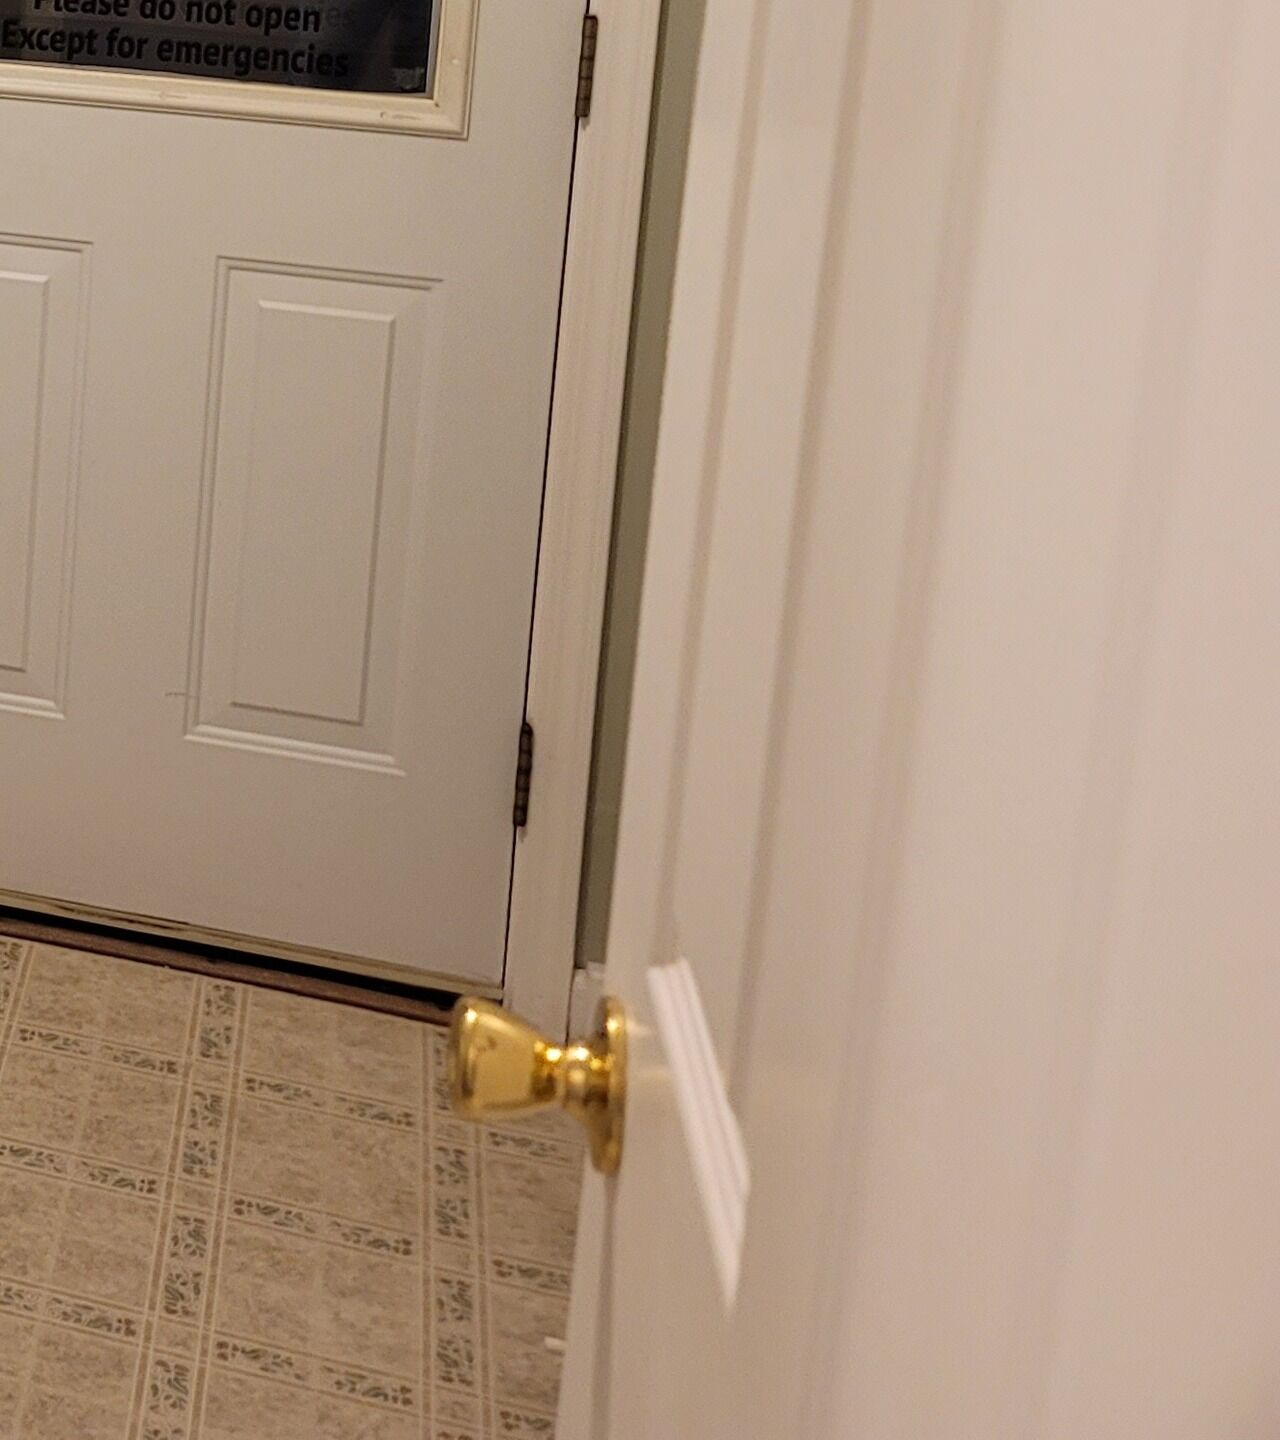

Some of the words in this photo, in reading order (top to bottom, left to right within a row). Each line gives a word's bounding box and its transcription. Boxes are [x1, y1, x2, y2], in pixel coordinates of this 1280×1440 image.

[186, 0, 237, 27] not
[245, 6, 321, 36] open
[1, 18, 99, 60] Except
[106, 27, 149, 60] for
[156, 38, 351, 77] emergencies
